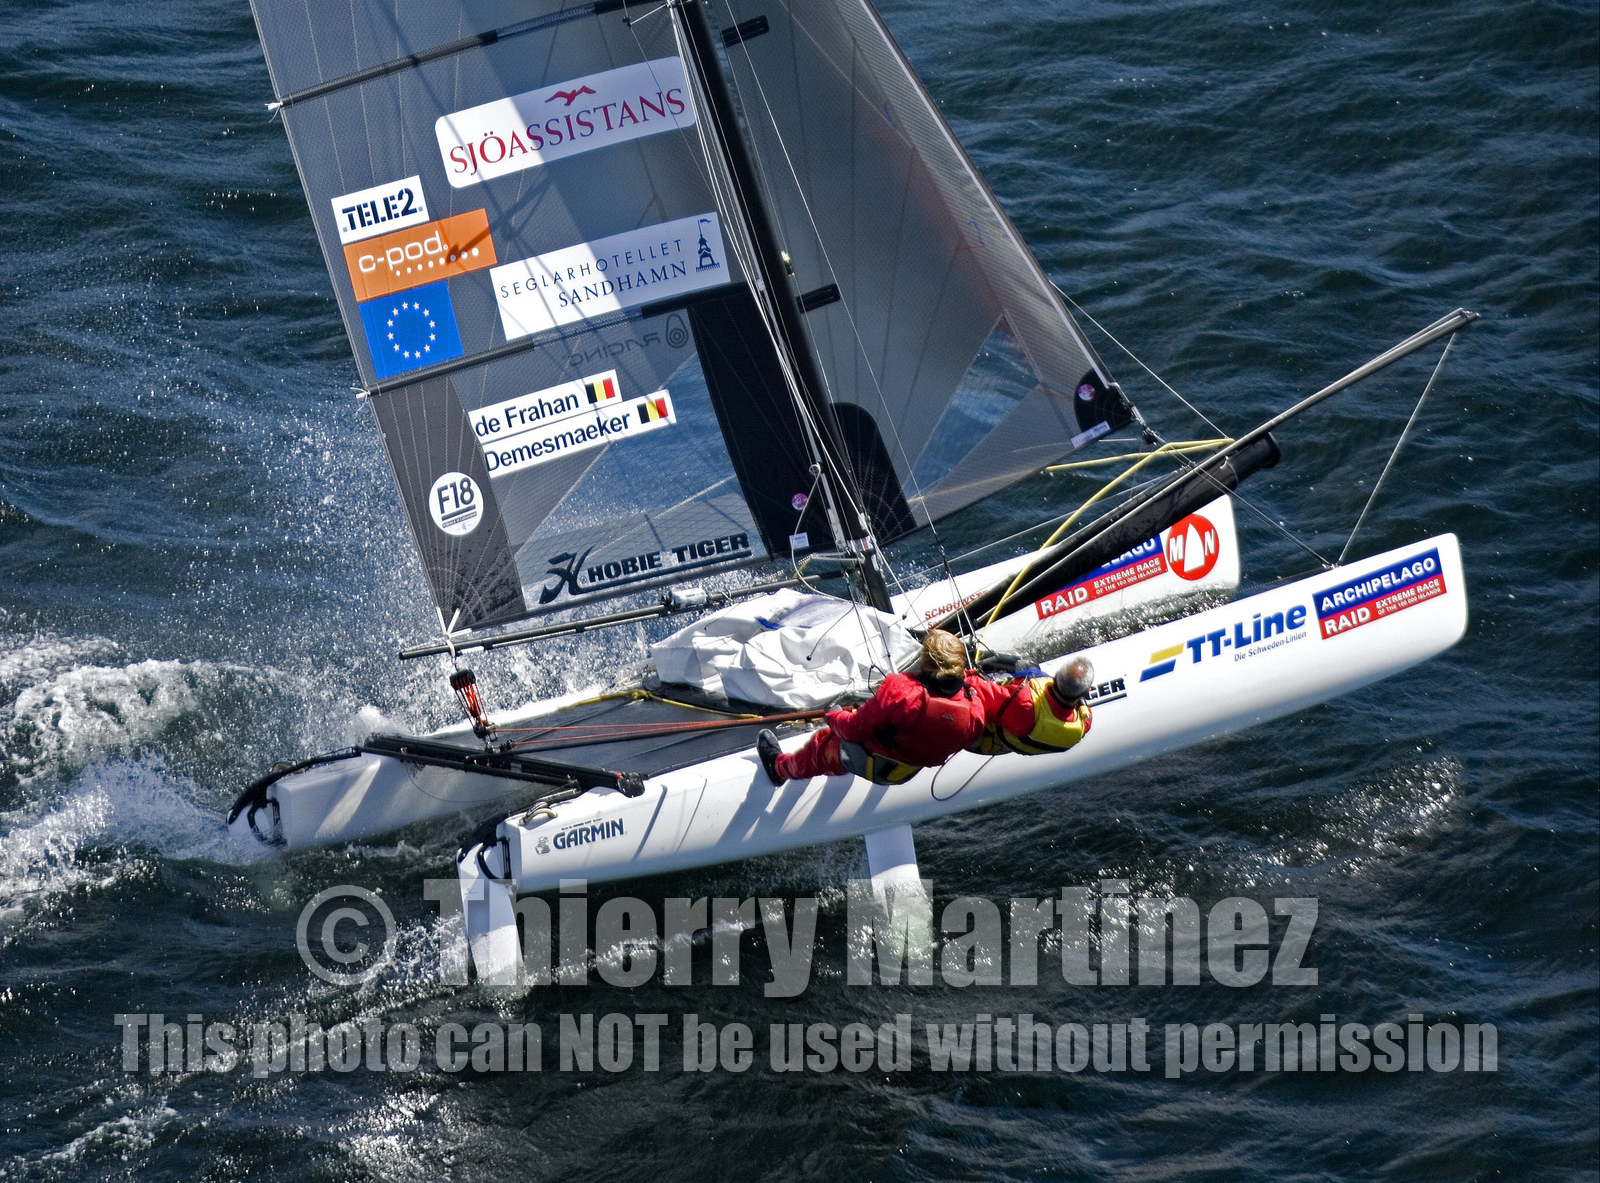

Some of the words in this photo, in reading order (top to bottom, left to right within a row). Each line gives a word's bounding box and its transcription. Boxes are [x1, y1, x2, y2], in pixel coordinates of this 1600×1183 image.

[449, 88, 686, 175] SJÖASSISTANS
[501, 239, 681, 298] SEGLARHOTELLET
[559, 261, 687, 308] SANDHAMN
[475, 415, 501, 437] de
[504, 393, 580, 428] Frahan
[485, 413, 631, 472] Demesmaeker
[437, 477, 475, 514] F18
[587, 551, 662, 583] HOBIE
[672, 533, 750, 563] TIGER
[1093, 568, 1135, 589] EXTREME
[1136, 557, 1161, 573] RACE
[1040, 586, 1088, 616] RAID
[1321, 557, 1436, 612] ARCHIPELAGO
[1376, 587, 1416, 609] EXTREME
[1416, 578, 1440, 592] RACE
[1187, 604, 1307, 664] TT-Line
[1324, 606, 1371, 636] RAID
[1234, 652, 1246, 662] Die
[1247, 630, 1307, 656] Schweden-Linien
[553, 818, 624, 850] GARMIN
